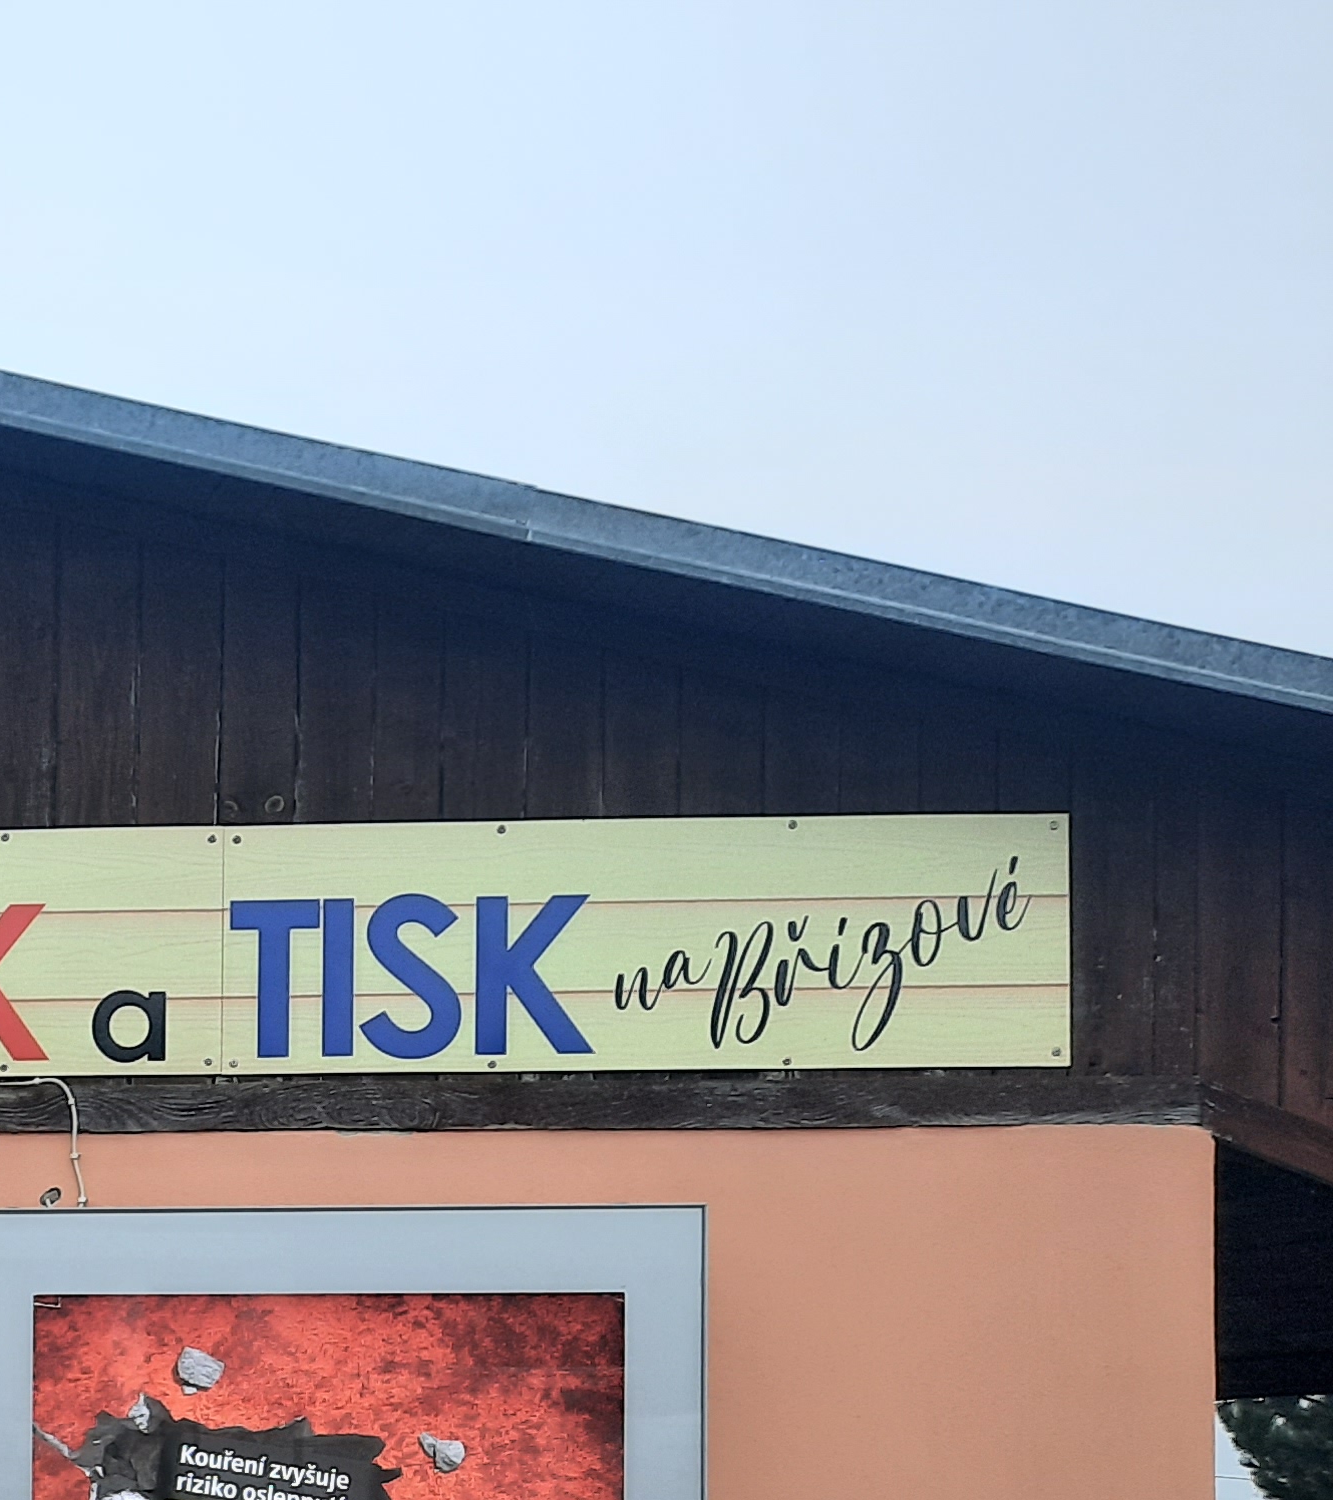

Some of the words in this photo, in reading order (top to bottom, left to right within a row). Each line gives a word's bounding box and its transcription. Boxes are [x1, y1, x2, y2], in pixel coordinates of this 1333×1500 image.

[91, 990, 166, 1063] a
[229, 893, 595, 1060] TISK
[613, 949, 711, 1011] na
[710, 857, 1031, 1052] Břízové
[176, 1472, 237, 1499] riziko
[179, 1444, 266, 1476] Kouření
[270, 1460, 350, 1492] zvyšuje
